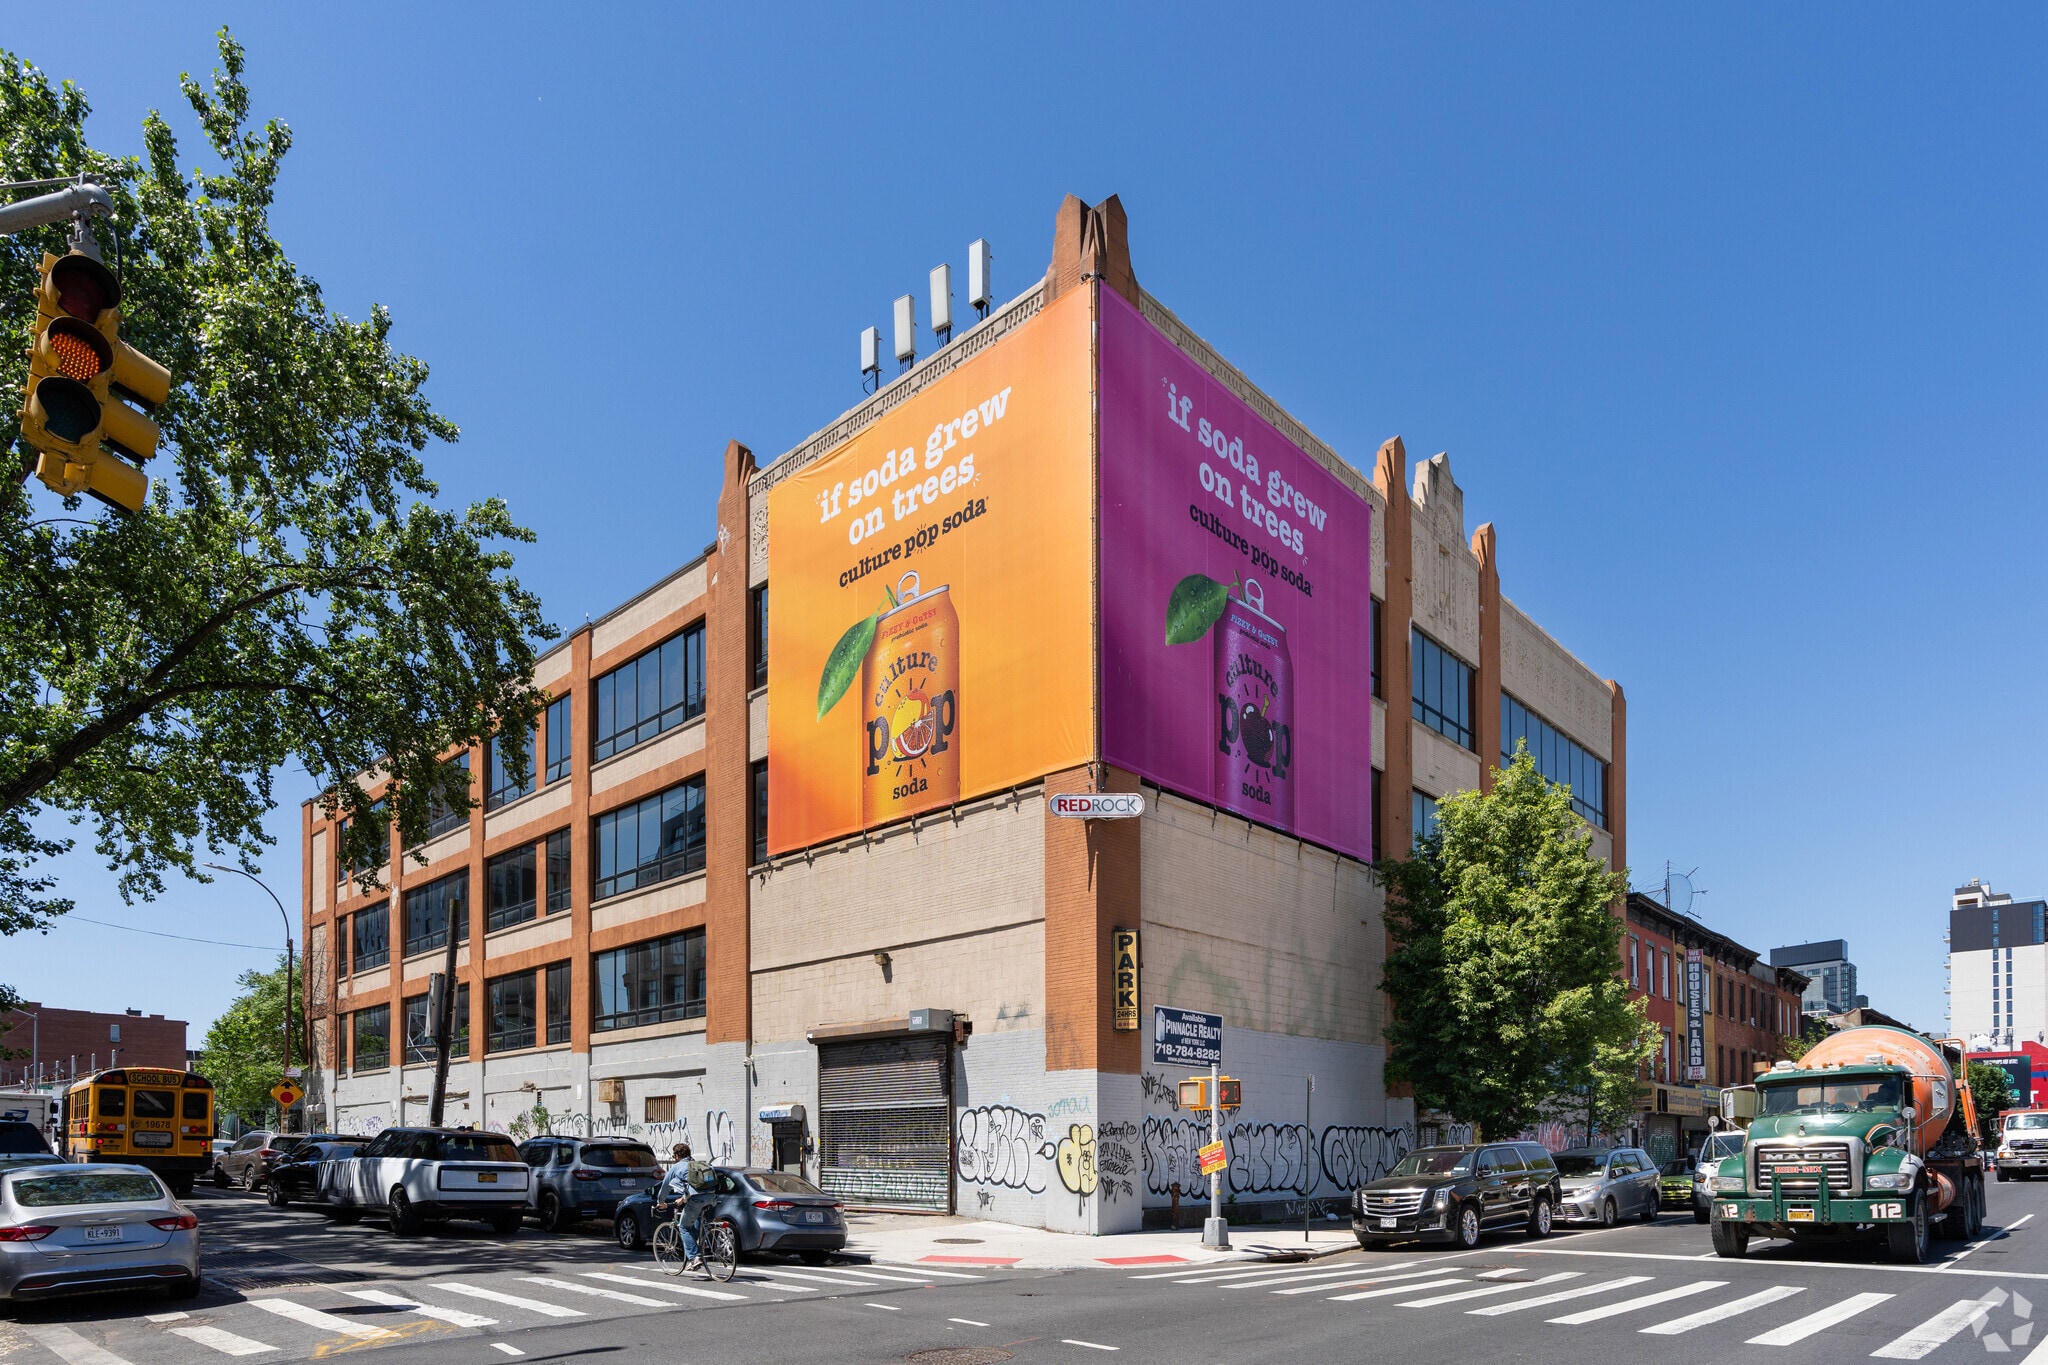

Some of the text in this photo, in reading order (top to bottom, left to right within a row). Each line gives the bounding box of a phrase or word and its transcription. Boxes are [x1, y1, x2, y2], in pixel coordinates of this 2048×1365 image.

[819, 386, 1012, 524] if soda grew
[1167, 383, 1327, 532] if soda grew
[848, 453, 975, 546] on trees
[1199, 462, 1304, 556] on trees
[839, 496, 987, 588] culture pop soda
[1189, 503, 1313, 598] culture pop soda
[905, 619, 911, 628] &
[915, 622, 929, 632] soda
[875, 651, 938, 707] culture
[1226, 653, 1279, 698] culture
[892, 777, 929, 800] soda
[1242, 781, 1272, 805] soda
[1118, 934, 1135, 1007] PARK
[1117, 1009, 1136, 1018] 24HRS
[1181, 1012, 1207, 1024] Available
[1688, 962, 1702, 1065] HOUSES & LAND
[1165, 1019, 1221, 1040] PINNACLE REALTY
[132, 1072, 177, 1083] SCHOOL BUS
[145, 1120, 171, 1129] 19678
[1765, 1152, 1839, 1160] MACK
[1774, 1165, 1823, 1174] REDI-MIX
[1869, 1203, 1902, 1219] 112
